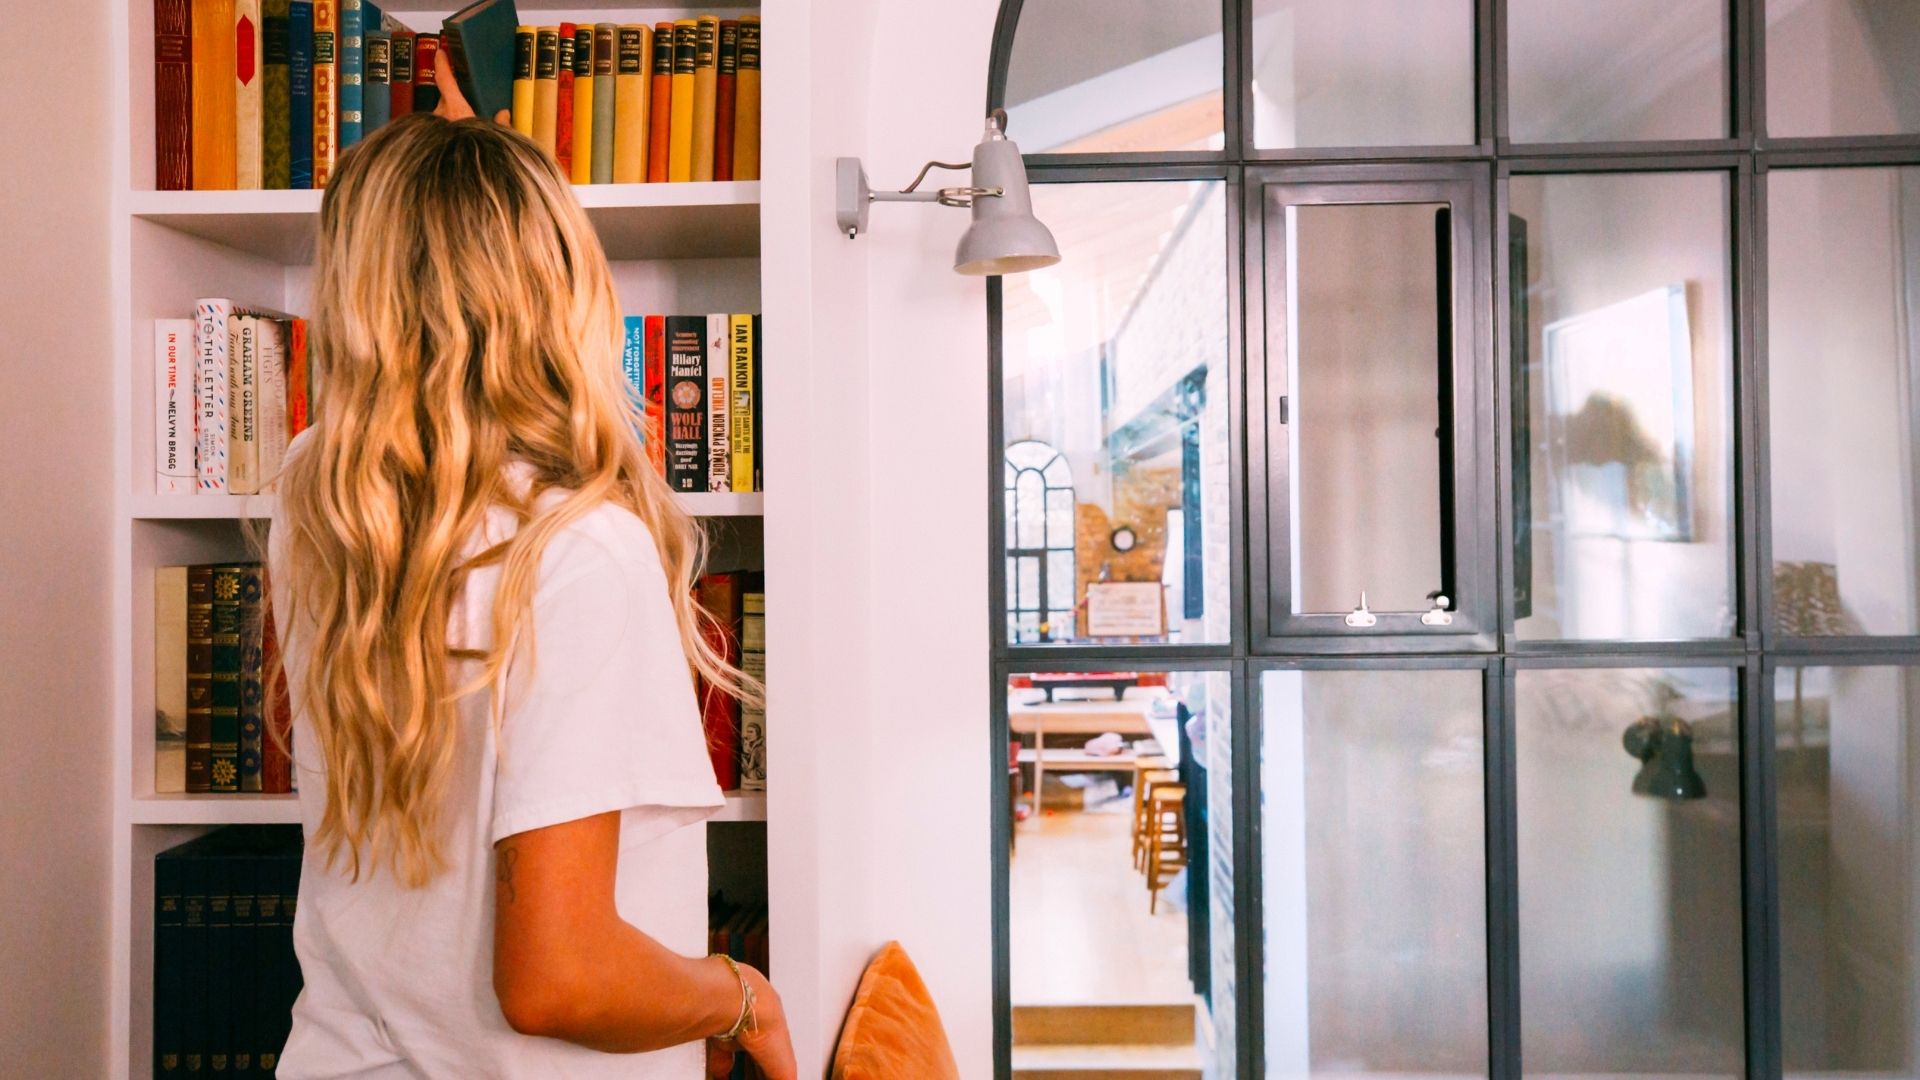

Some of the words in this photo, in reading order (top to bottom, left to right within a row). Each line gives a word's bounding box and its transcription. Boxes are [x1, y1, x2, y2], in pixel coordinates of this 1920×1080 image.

[168, 333, 176, 343] IN
[735, 324, 748, 343] IAN
[168, 345, 176, 364] OUR
[204, 339, 213, 365] THE
[242, 327, 253, 385] GRAHAM
[263, 347, 273, 385] FIGES
[672, 353, 701, 366] Hilary
[168, 365, 176, 389] TIME
[671, 366, 702, 377] Mantel
[736, 345, 750, 389] RANKIN
[204, 369, 214, 418] LETTER
[712, 377, 725, 413] VINELAND
[168, 401, 177, 438] MELVYN
[243, 390, 253, 442] GREENE
[671, 412, 703, 426] WOLF
[713, 413, 725, 446] PYNCHON
[672, 426, 702, 440] HALL
[168, 440, 177, 470] BRAGG
[713, 447, 725, 476] THOMAS
